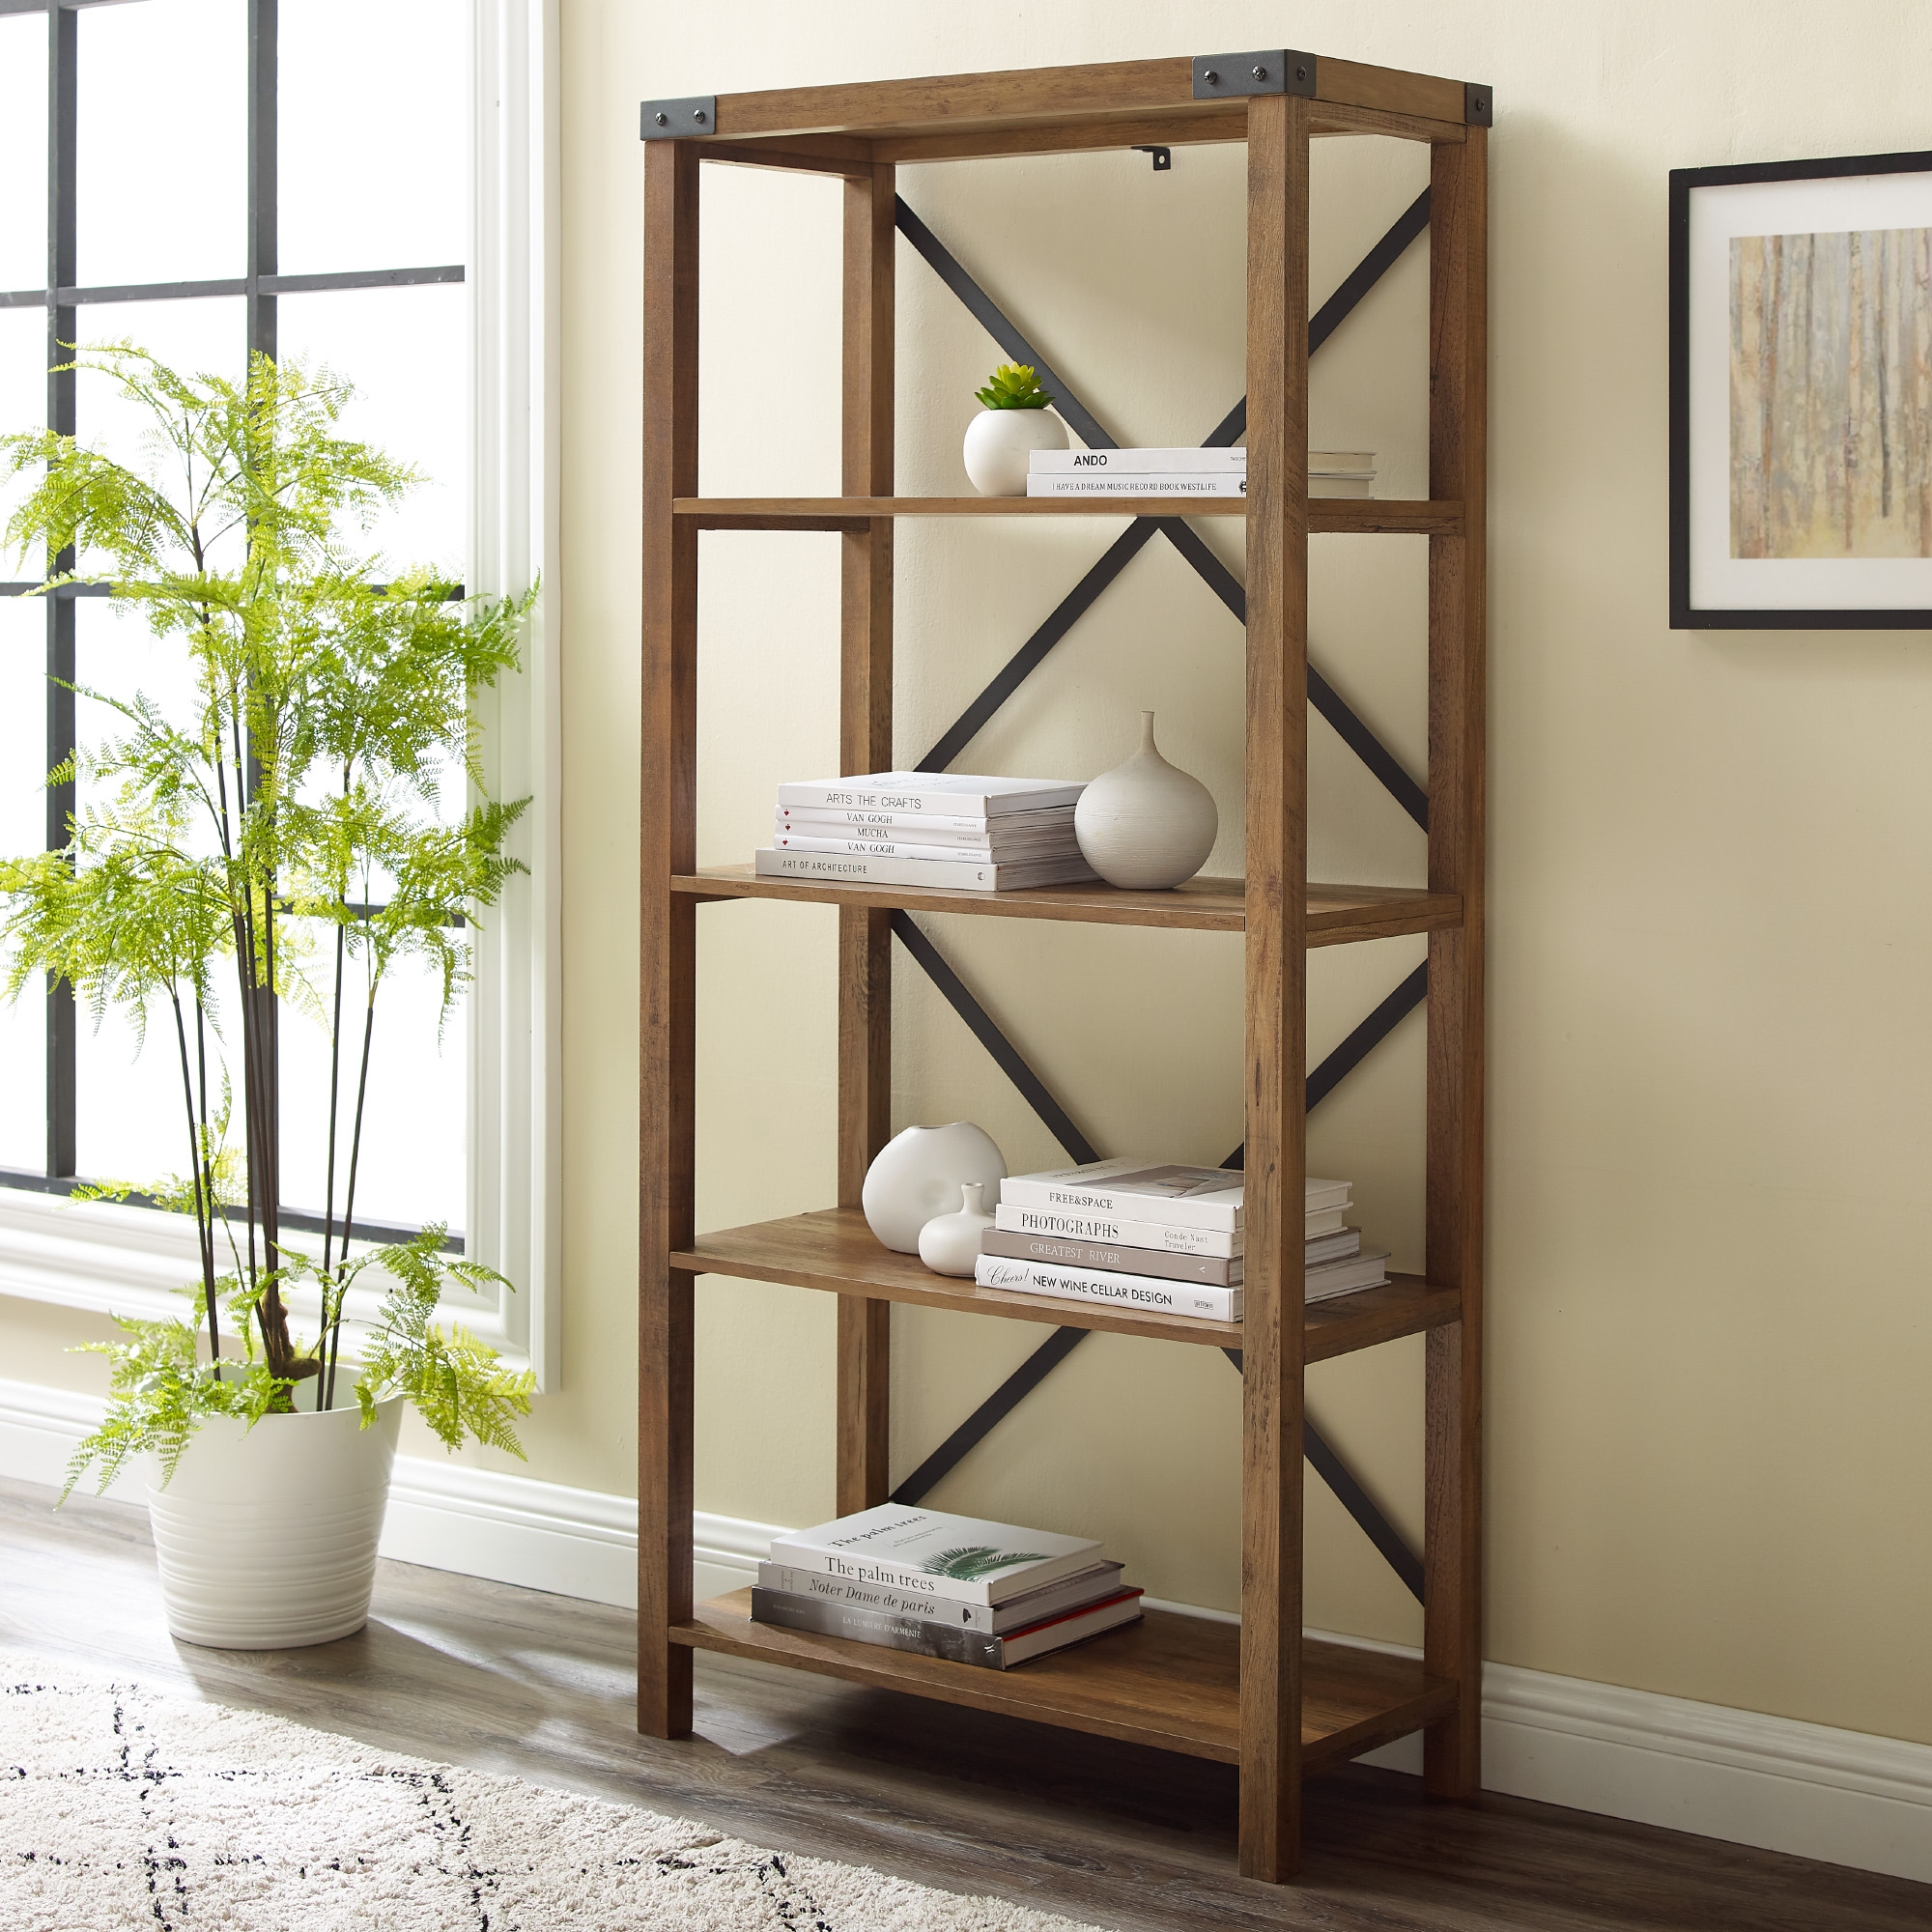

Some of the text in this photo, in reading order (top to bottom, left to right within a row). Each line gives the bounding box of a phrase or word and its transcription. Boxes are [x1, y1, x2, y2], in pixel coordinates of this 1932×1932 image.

[1073, 455, 1108, 467] ANDO
[826, 793, 922, 810] ARTS THE CRAFTS
[846, 812, 893, 824] VAN GOGH
[857, 828, 889, 838] MUCHA
[847, 841, 895, 854] VAN GOGH
[782, 860, 867, 874] ART OF ARCHITECTURE
[1049, 1191, 1114, 1209] FREE&SPACE
[1021, 1212, 1120, 1239] PHOTOGRAPHS
[1164, 1231, 1208, 1243] Conde Nast
[1164, 1240, 1196, 1251] Traveler
[1030, 1242, 1121, 1264] GREATEST RIVER
[987, 1265, 1173, 1306] Cheers! NEW WINE CELLAR DESIGN
[824, 1556, 935, 1592] The palm trees
[809, 1578, 843, 1596] Noter
[845, 1586, 880, 1604] Dame
[883, 1594, 897, 1607] de
[900, 1598, 935, 1615] paris
[842, 1616, 852, 1625] LA
